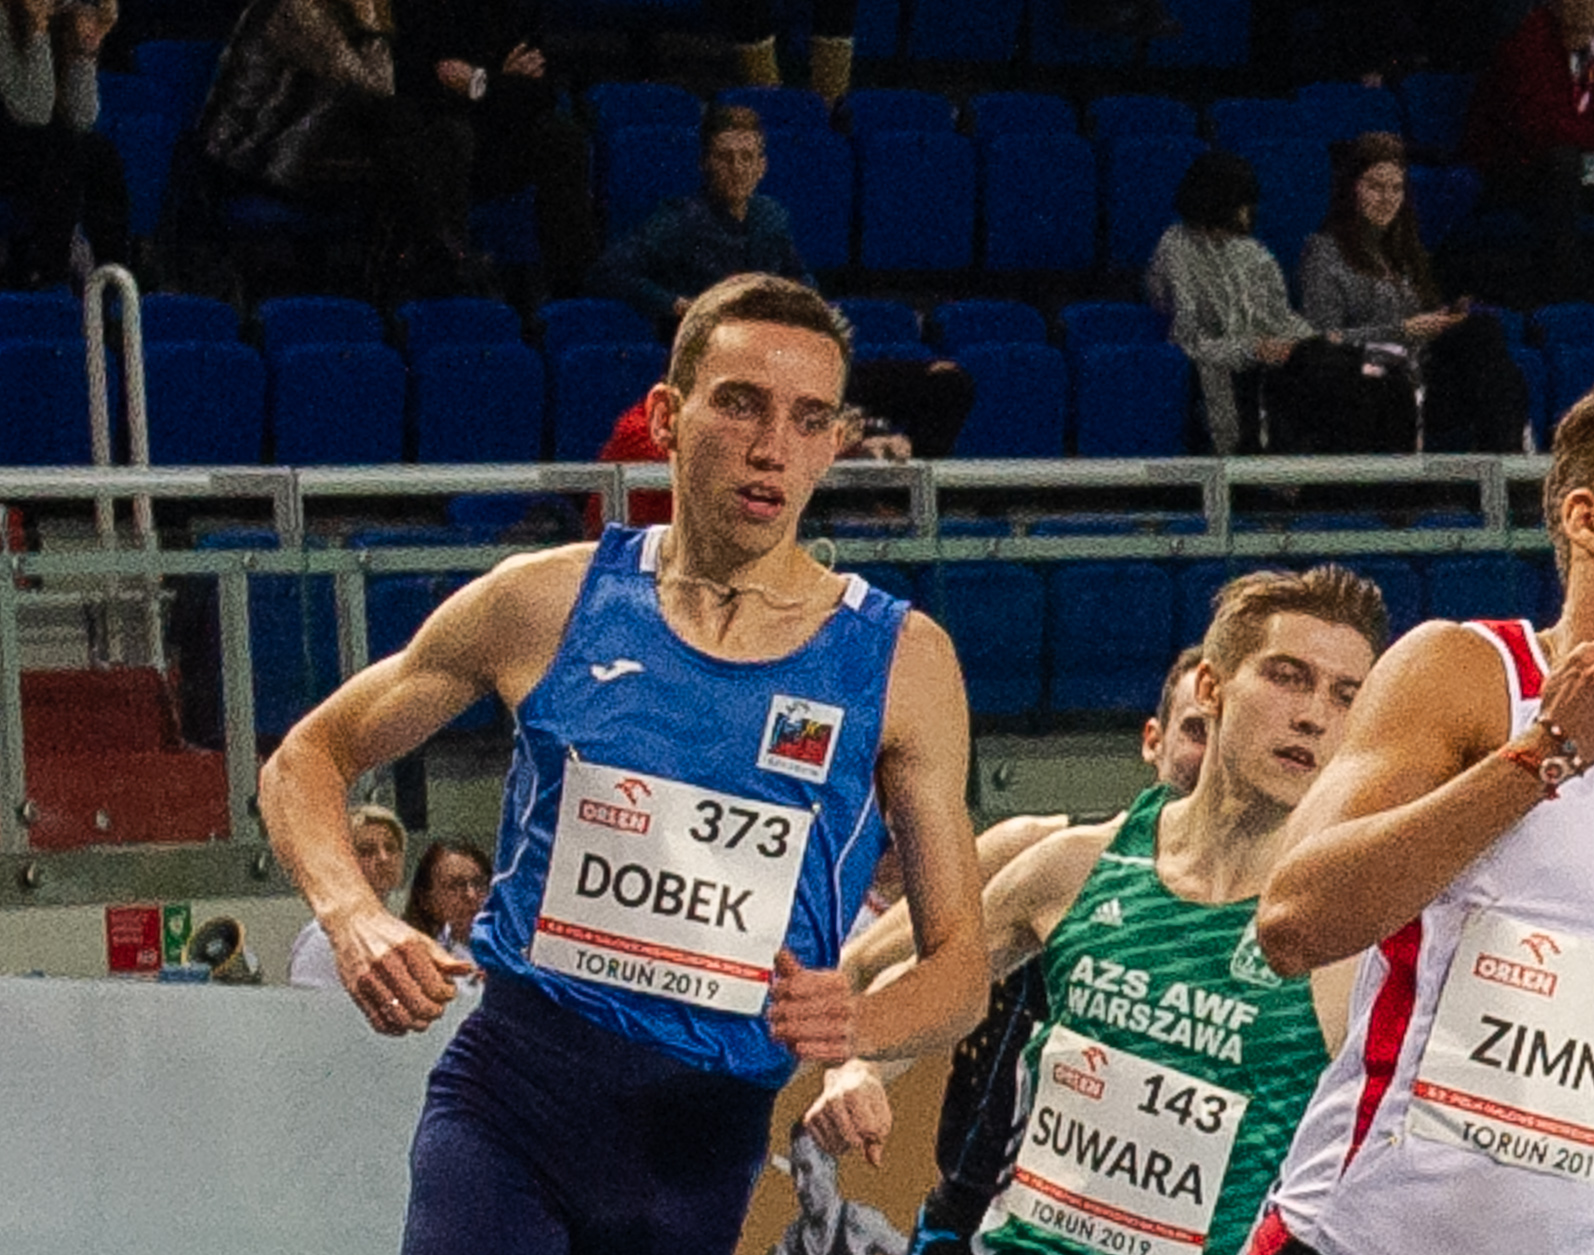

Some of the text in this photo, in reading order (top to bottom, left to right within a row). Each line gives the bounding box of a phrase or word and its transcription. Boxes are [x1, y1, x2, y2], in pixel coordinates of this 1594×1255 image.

[581, 801, 649, 834] ORLEN
[689, 799, 792, 859] 373
[575, 852, 754, 933] DOBEK
[661, 970, 721, 1000] 2019
[1069, 954, 1260, 1031] AZS AWF
[1476, 957, 1555, 995] ORLEN
[1067, 984, 1244, 1066] WARSZAWA
[1137, 1073, 1229, 1134] 143
[1031, 1105, 1204, 1206] SUWARA
[1462, 1120, 1549, 1165] TORUŃ
[1030, 1199, 1096, 1240] TORUŃ
